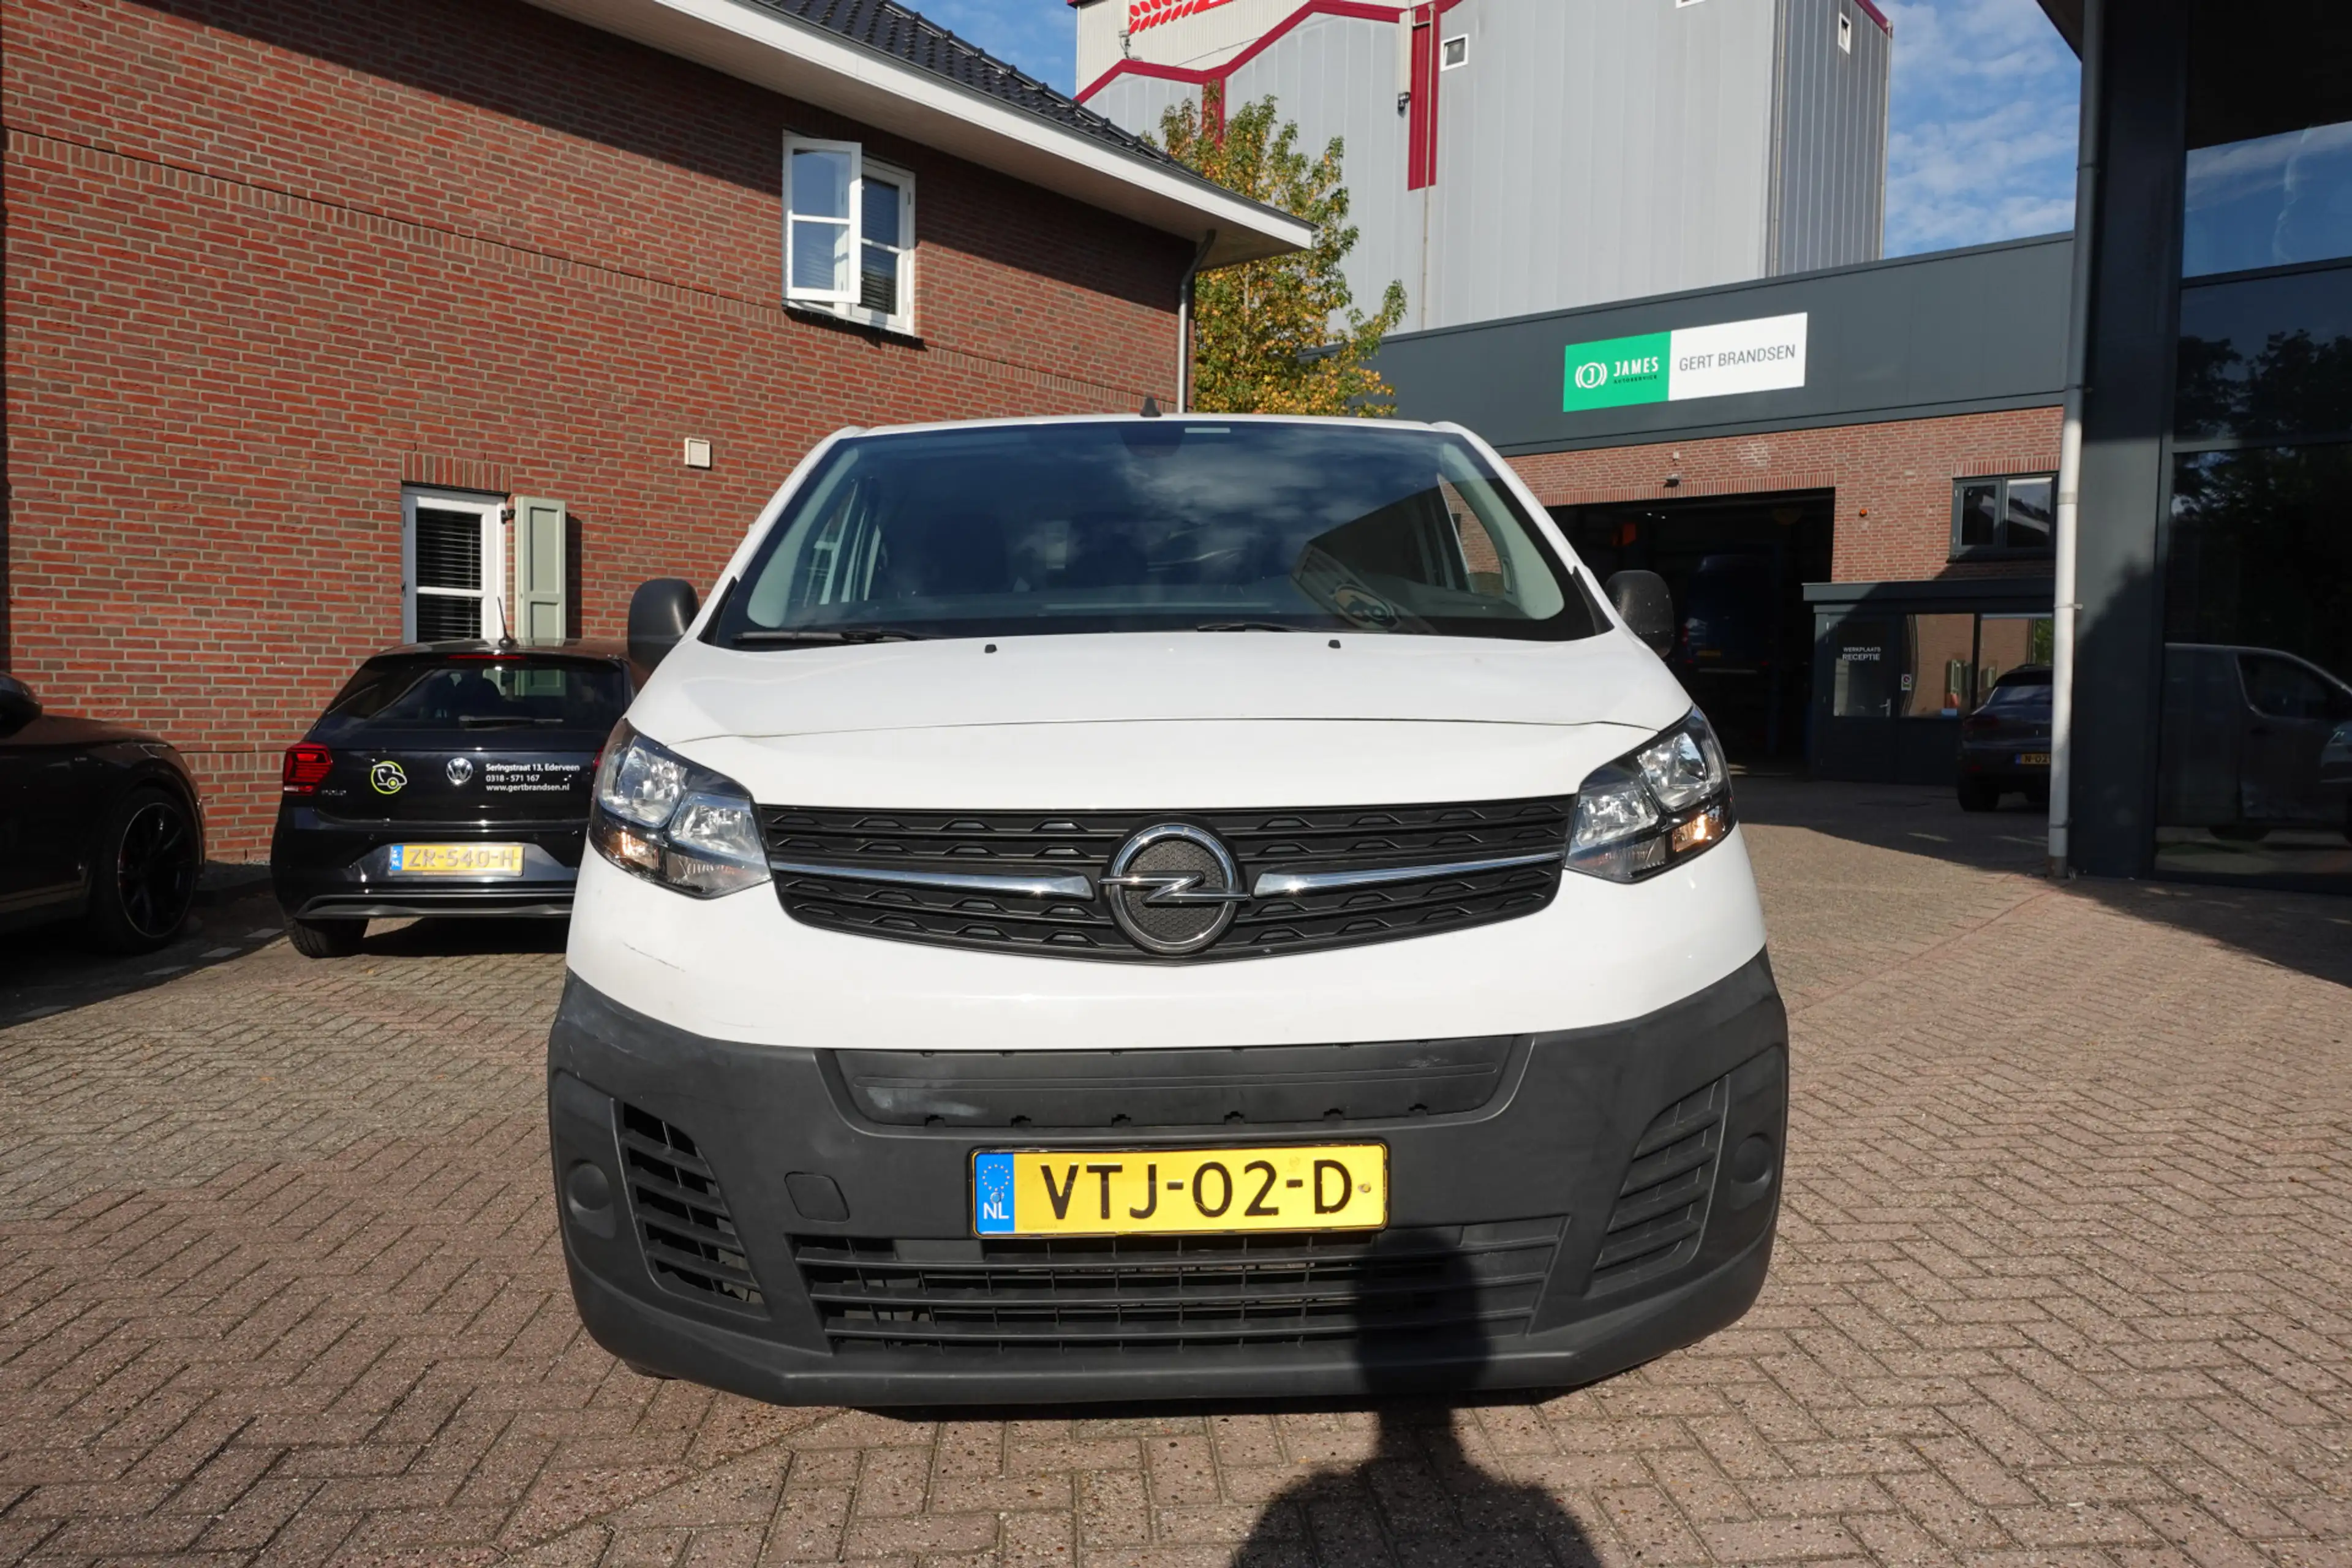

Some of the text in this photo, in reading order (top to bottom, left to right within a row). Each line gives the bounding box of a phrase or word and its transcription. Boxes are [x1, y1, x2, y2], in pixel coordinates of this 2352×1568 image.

[1613, 356, 1659, 377] JAMES
[1679, 344, 1796, 371] GERT BRANDSEN
[485, 763, 581, 772] Seringstraat 13, Ederveen
[486, 783, 570, 793] www.gertbrandsen.nl
[409, 848, 514, 867] ZR-540-H
[1040, 1159, 1352, 1220] VTJ-02-D
[983, 1202, 1010, 1219] NL
